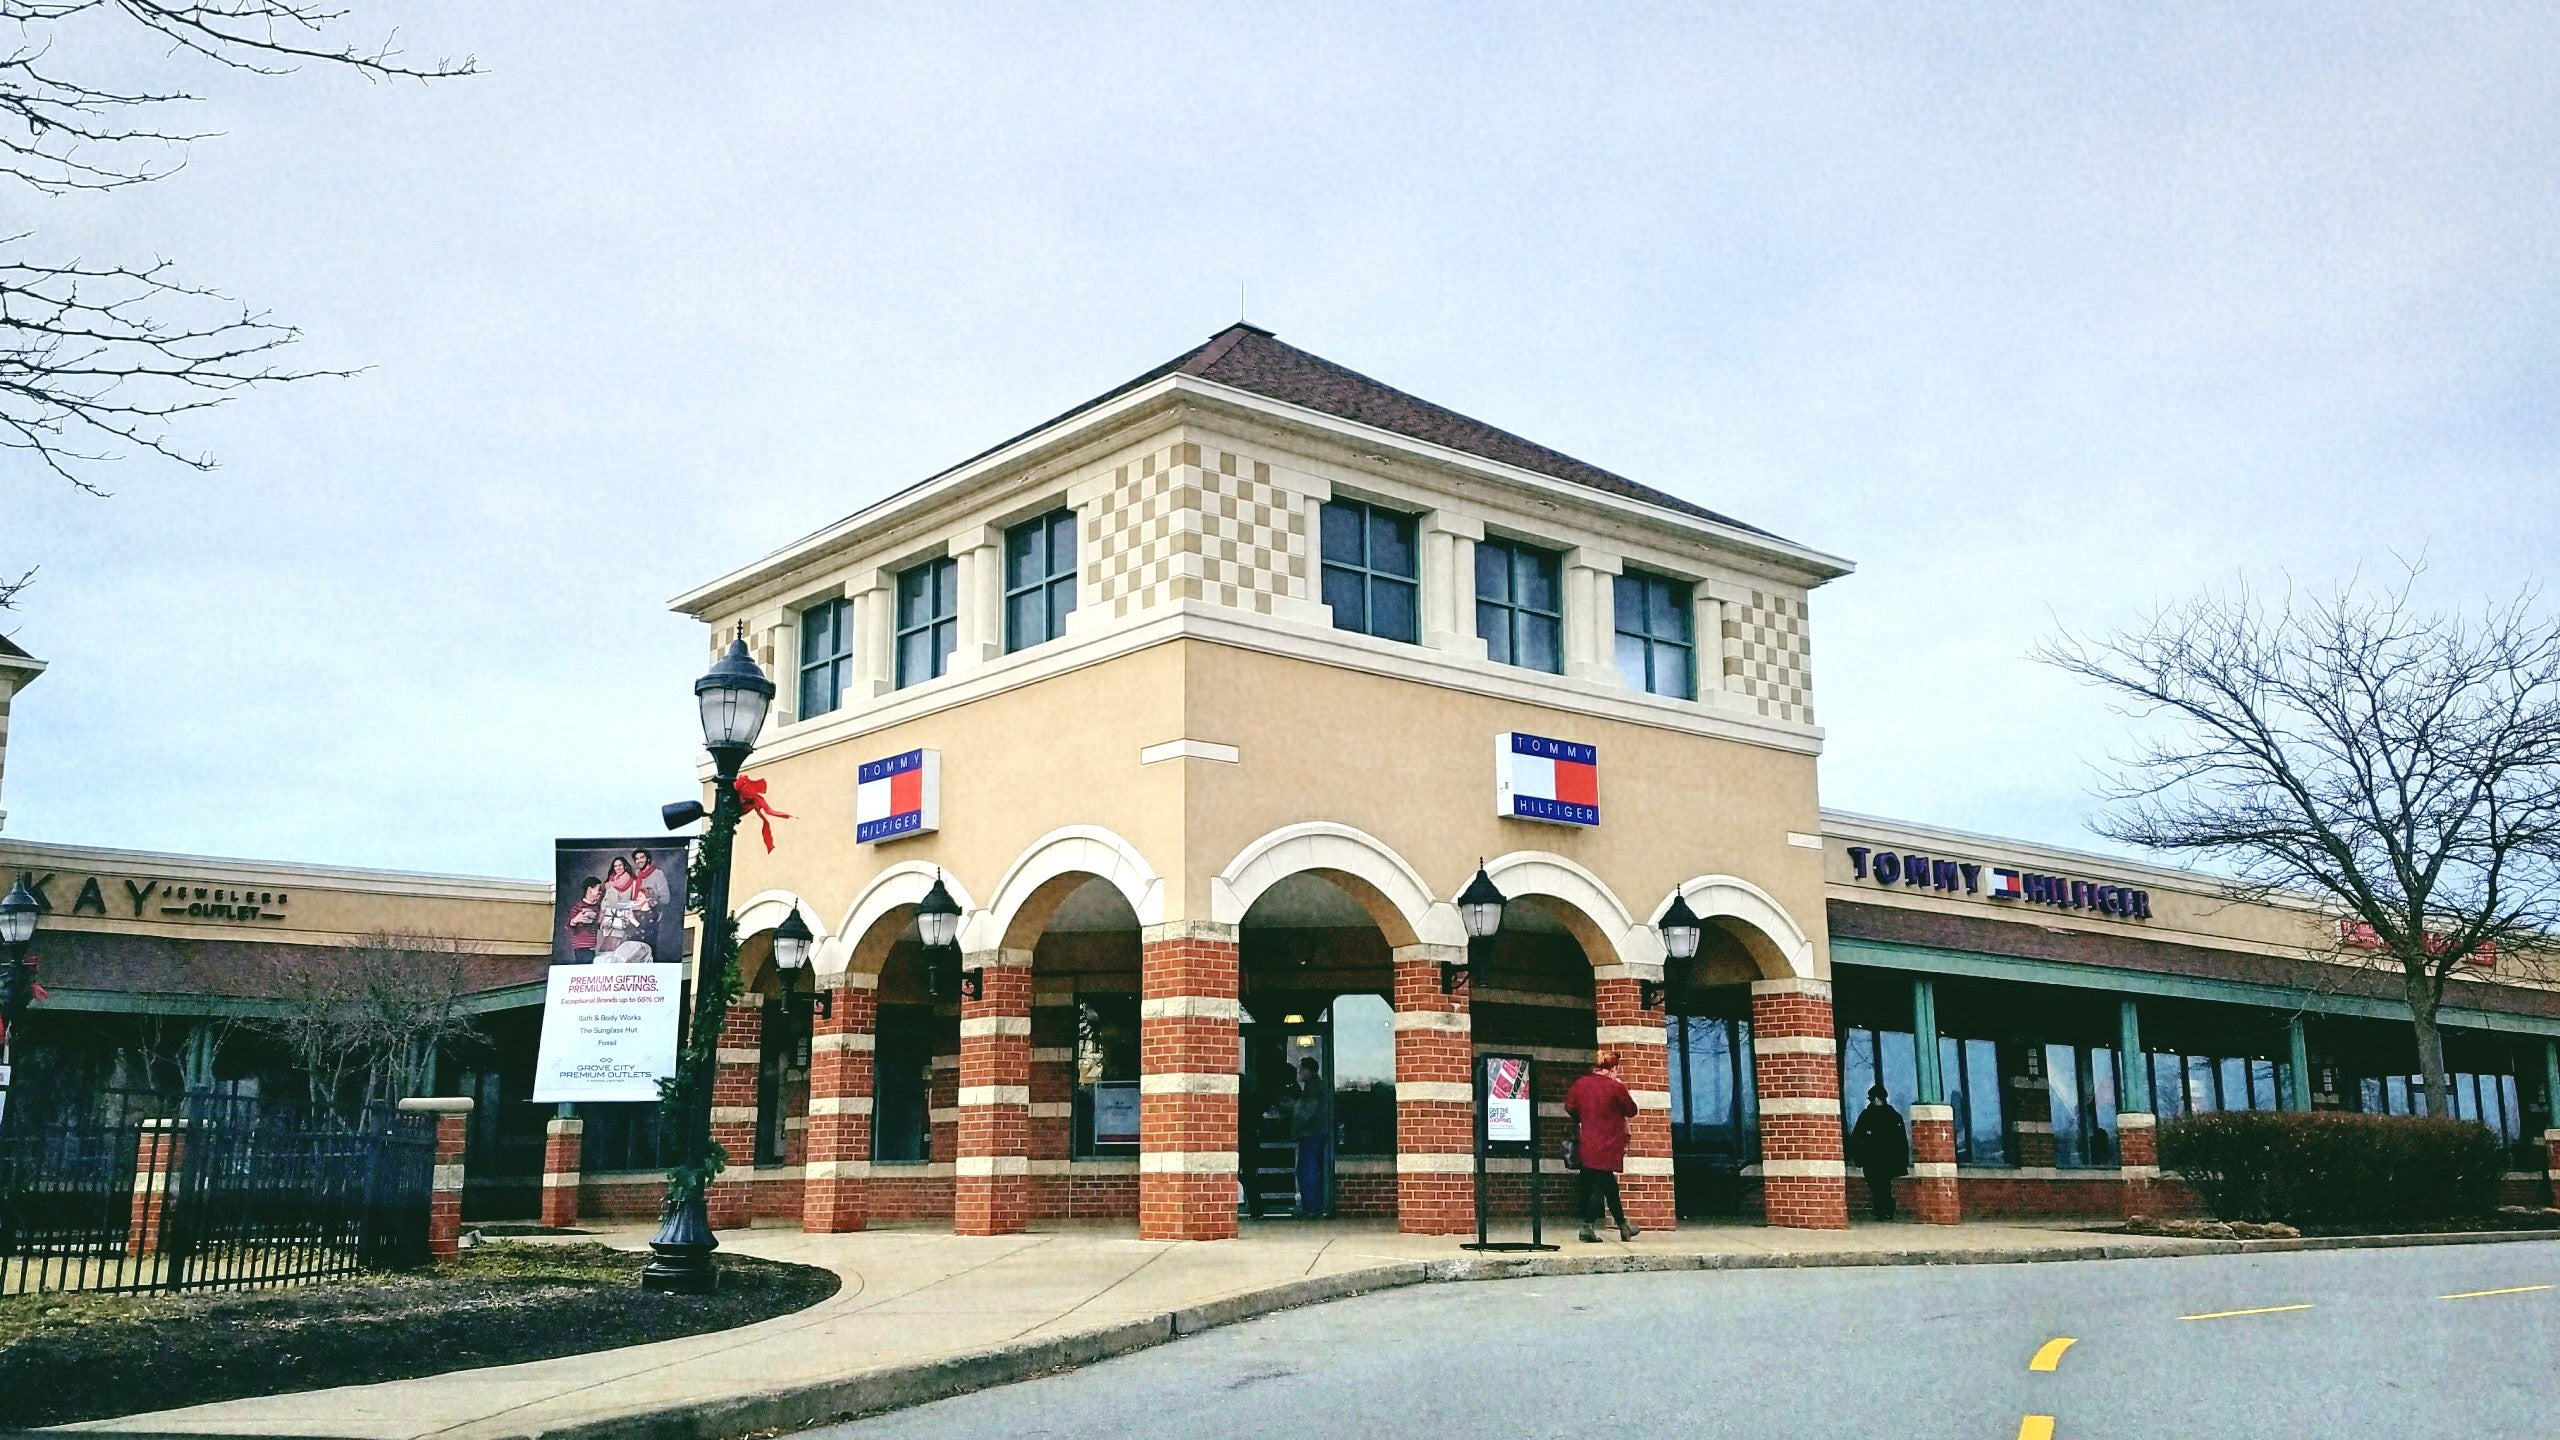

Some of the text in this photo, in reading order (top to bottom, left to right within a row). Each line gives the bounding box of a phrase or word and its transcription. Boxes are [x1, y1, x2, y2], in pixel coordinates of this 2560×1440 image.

[1517, 737, 1593, 760] TOMMY
[863, 753, 920, 779] TOMMY
[1520, 799, 1594, 821] HILFIGER
[861, 813, 918, 838] HILFIGER
[1847, 847, 2153, 919] TOMMY HILFIGER
[23, 871, 288, 918] KAY JEWELERS
[187, 902, 261, 921] OUTLET
[568, 983, 659, 993] PREMIUM SAVINGS.
[570, 975, 658, 985] PREMIUM GIFTING.
[560, 997, 595, 1005] Exceptional
[596, 996, 618, 1004] Brands
[600, 1014, 618, 1022] Body
[619, 1013, 642, 1021] Works
[593, 1026, 624, 1035] Sunglass
[559, 1071, 606, 1079] PREMIUM
